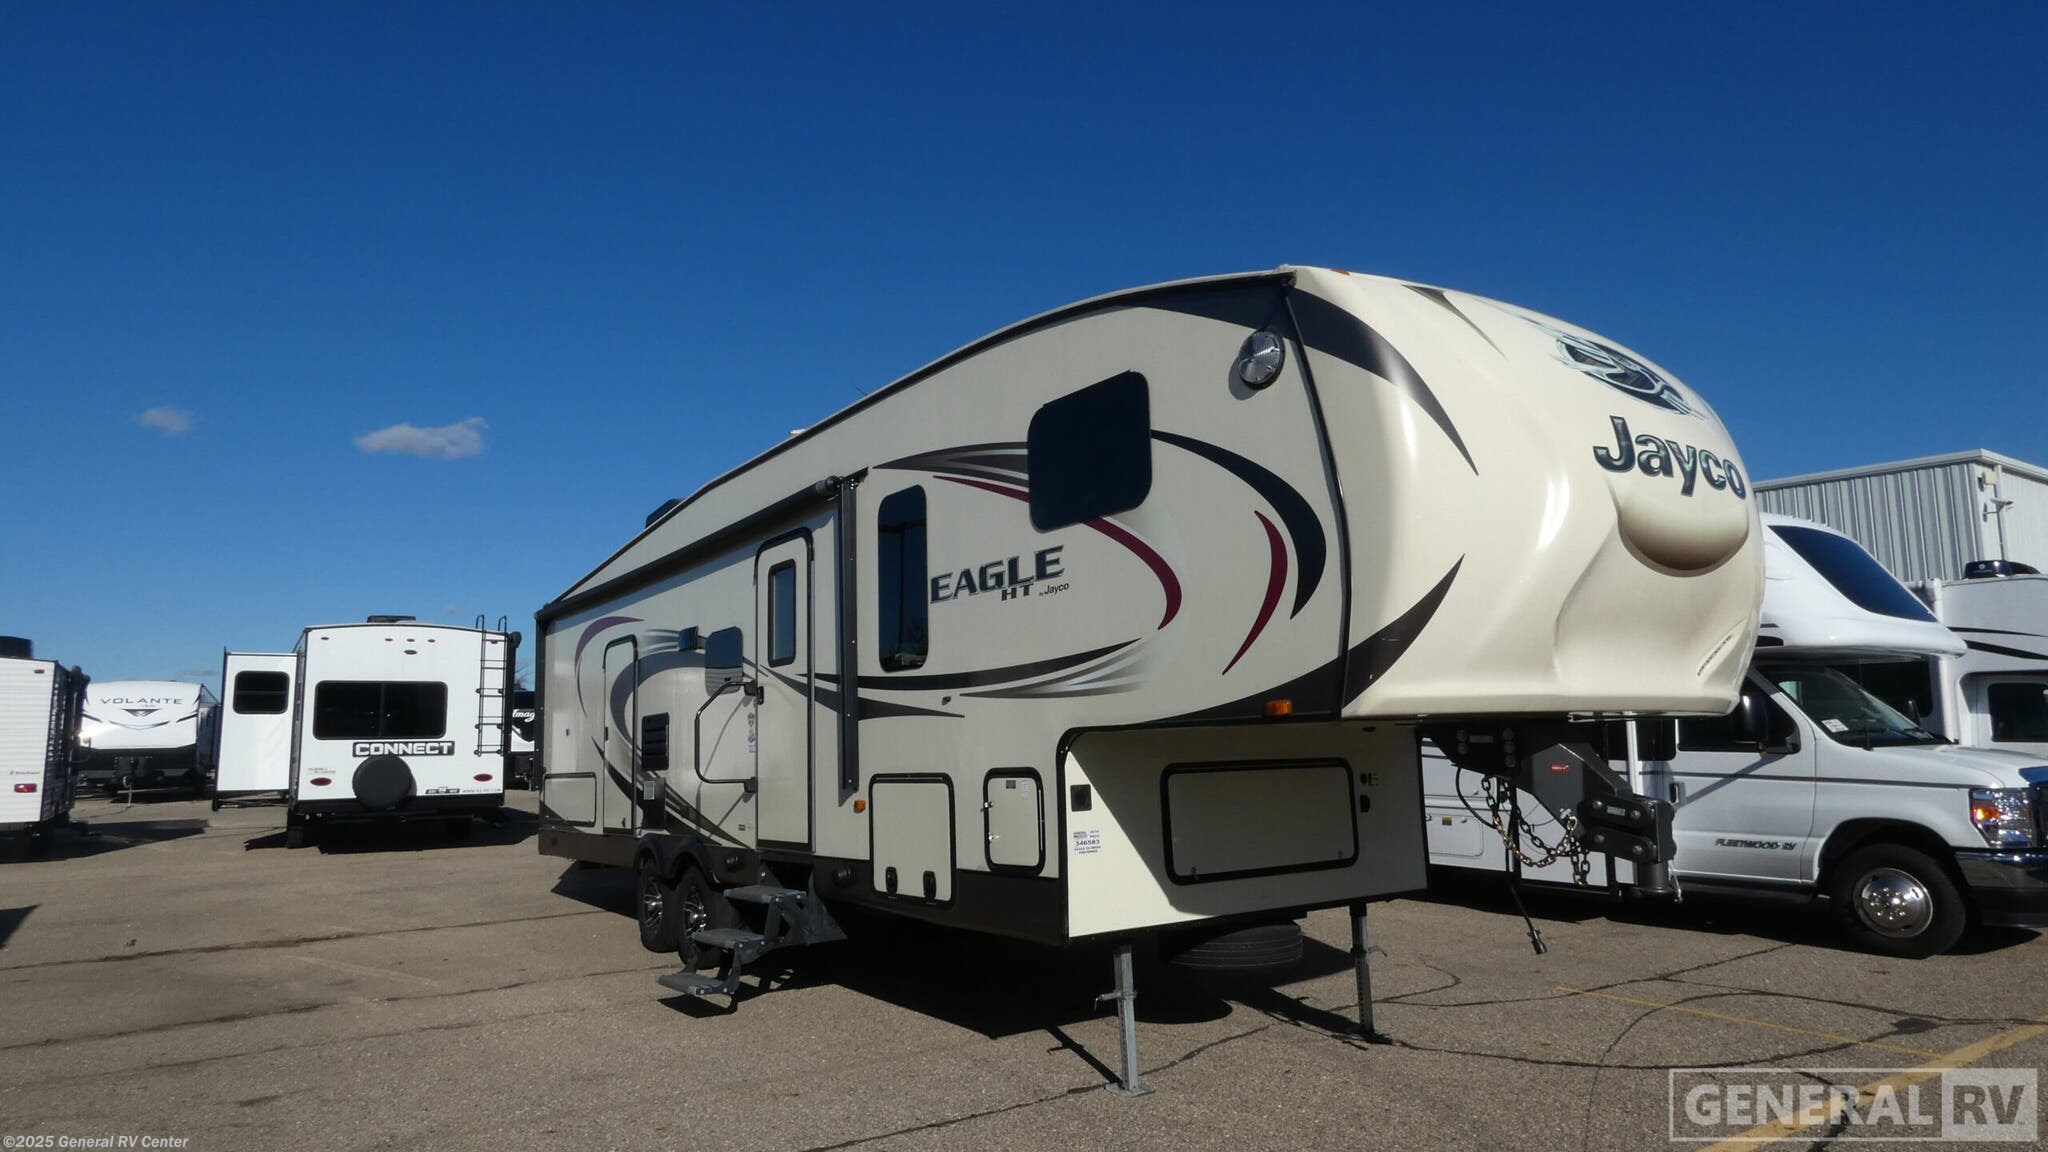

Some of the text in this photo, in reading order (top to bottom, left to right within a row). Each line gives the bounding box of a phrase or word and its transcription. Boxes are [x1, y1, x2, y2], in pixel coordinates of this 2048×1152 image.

[1593, 415, 1746, 500] Jayco
[930, 544, 1065, 604] EAGLE
[1001, 583, 1034, 601] HT
[1044, 583, 1070, 595] Jayco
[101, 697, 182, 705] VOLANTE
[355, 742, 452, 756] CONNECT
[1715, 838, 1797, 851] FLEETWOOD RV
